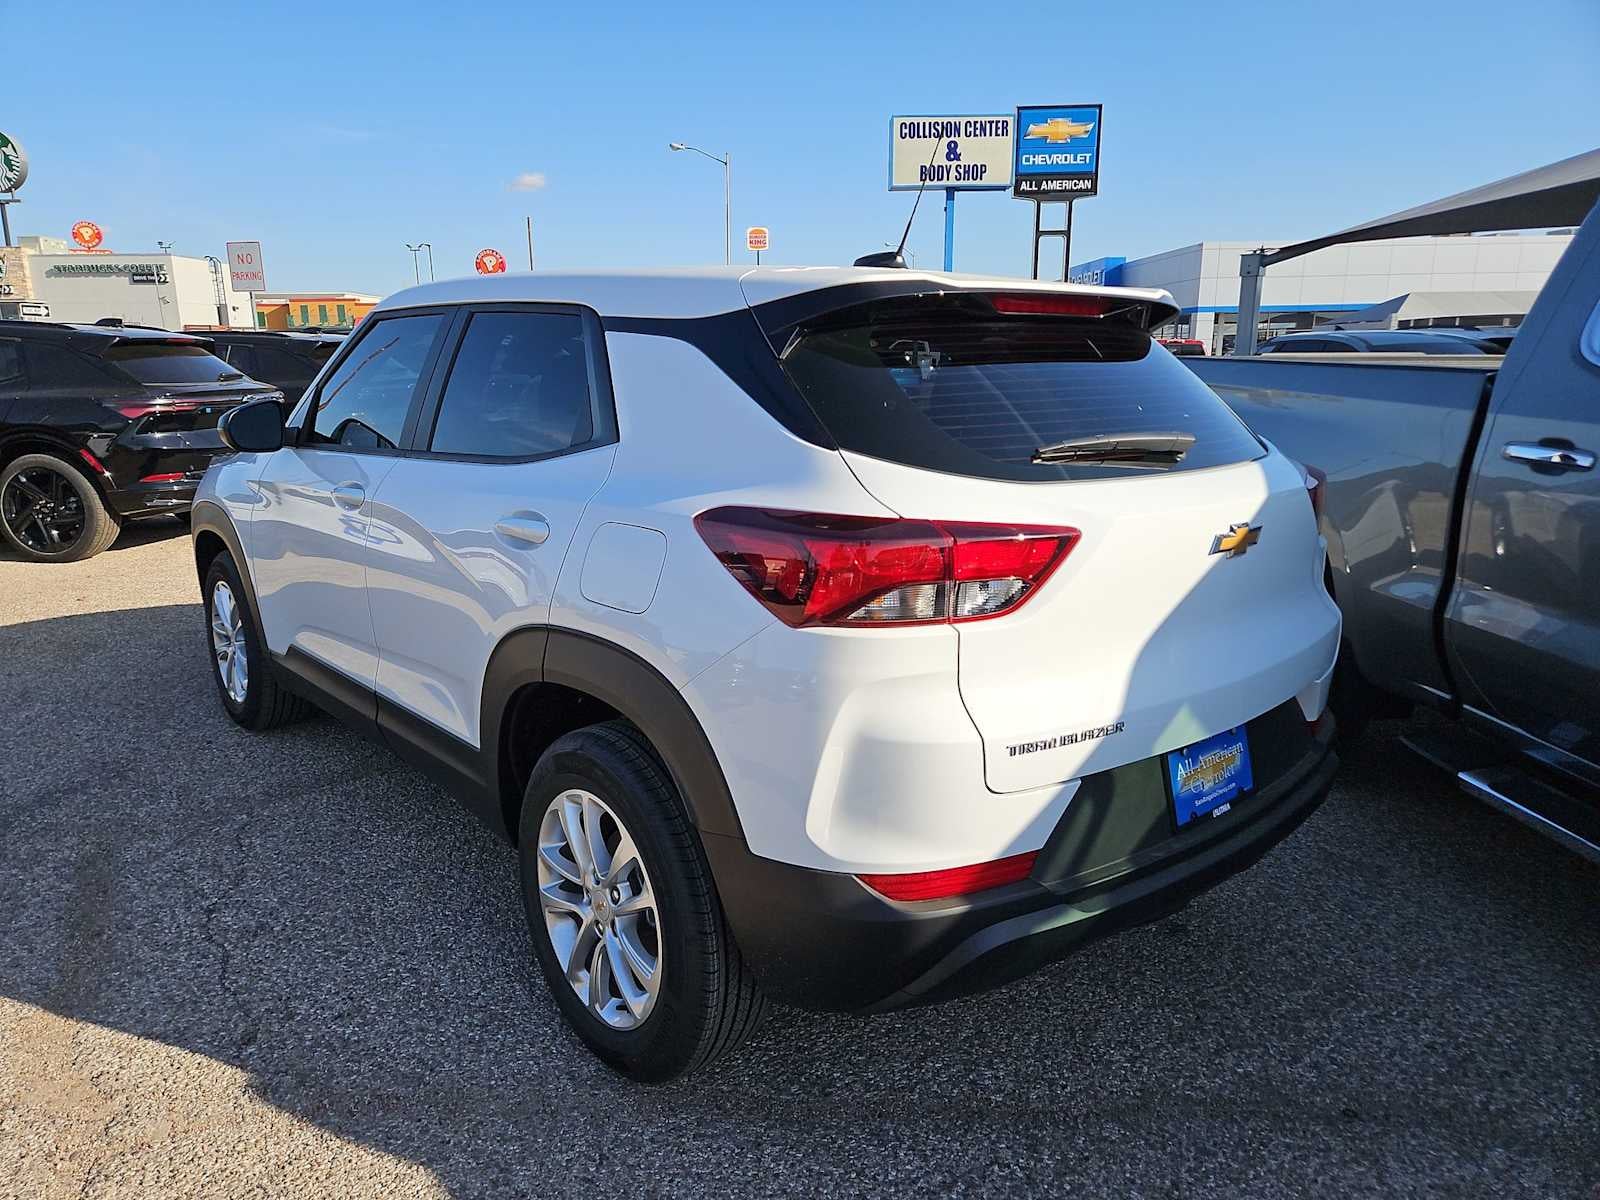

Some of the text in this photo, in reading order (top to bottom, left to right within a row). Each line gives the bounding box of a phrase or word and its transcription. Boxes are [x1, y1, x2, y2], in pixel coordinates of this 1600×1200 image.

[899, 119, 1009, 139] COLLISION CENTER
[945, 140, 962, 162] &
[1022, 153, 1092, 166] CHEVROLET
[919, 164, 987, 182] BODY SHOP
[1020, 179, 1092, 191] ALL AMERICAN
[237, 253, 253, 265] NO
[53, 263, 120, 273] STARBUCKS
[232, 271, 263, 281] PARKING
[1006, 721, 1125, 757] TRAILBLAZER
[1177, 742, 1244, 781] All American
